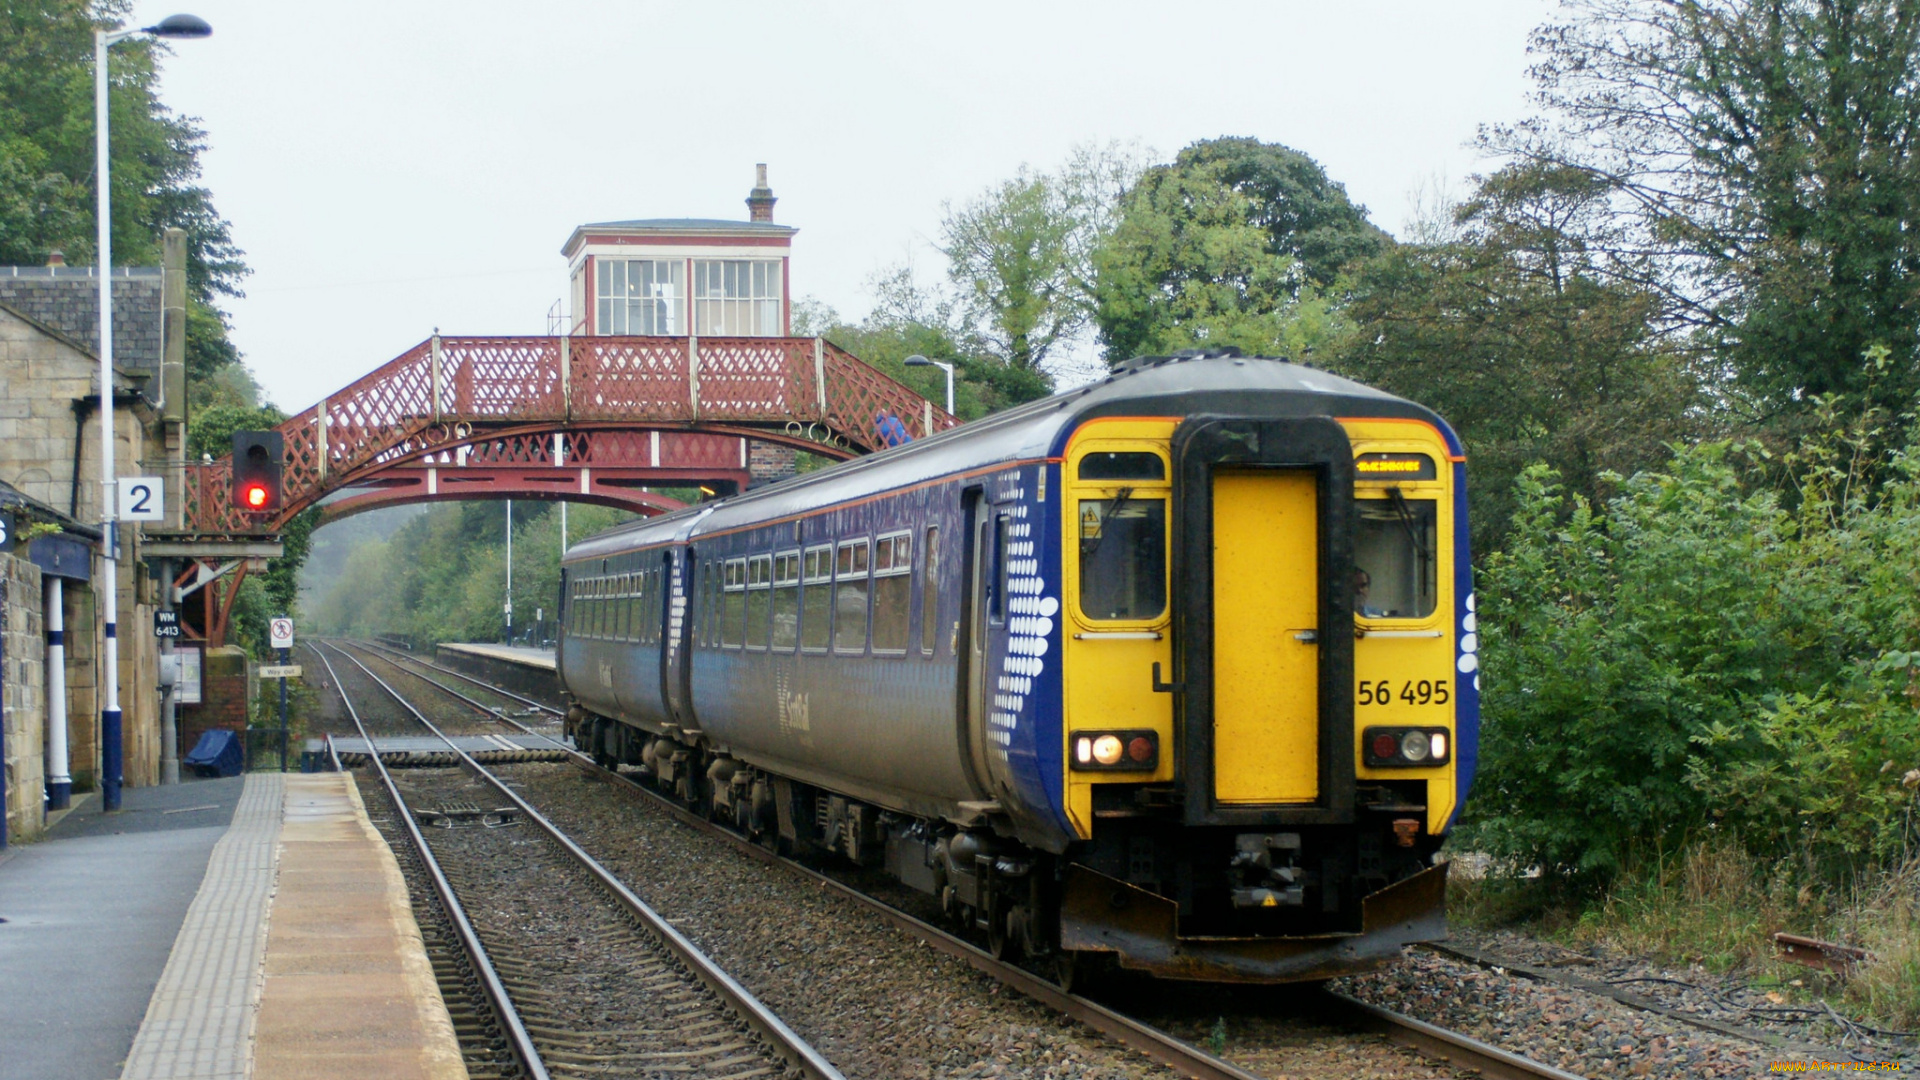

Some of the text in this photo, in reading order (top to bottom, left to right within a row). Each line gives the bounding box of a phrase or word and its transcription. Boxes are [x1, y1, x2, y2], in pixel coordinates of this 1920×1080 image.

[131, 485, 151, 513] 2
[159, 613, 175, 622] WM
[156, 626, 179, 636] 6413
[1400, 680, 1448, 705] 495
